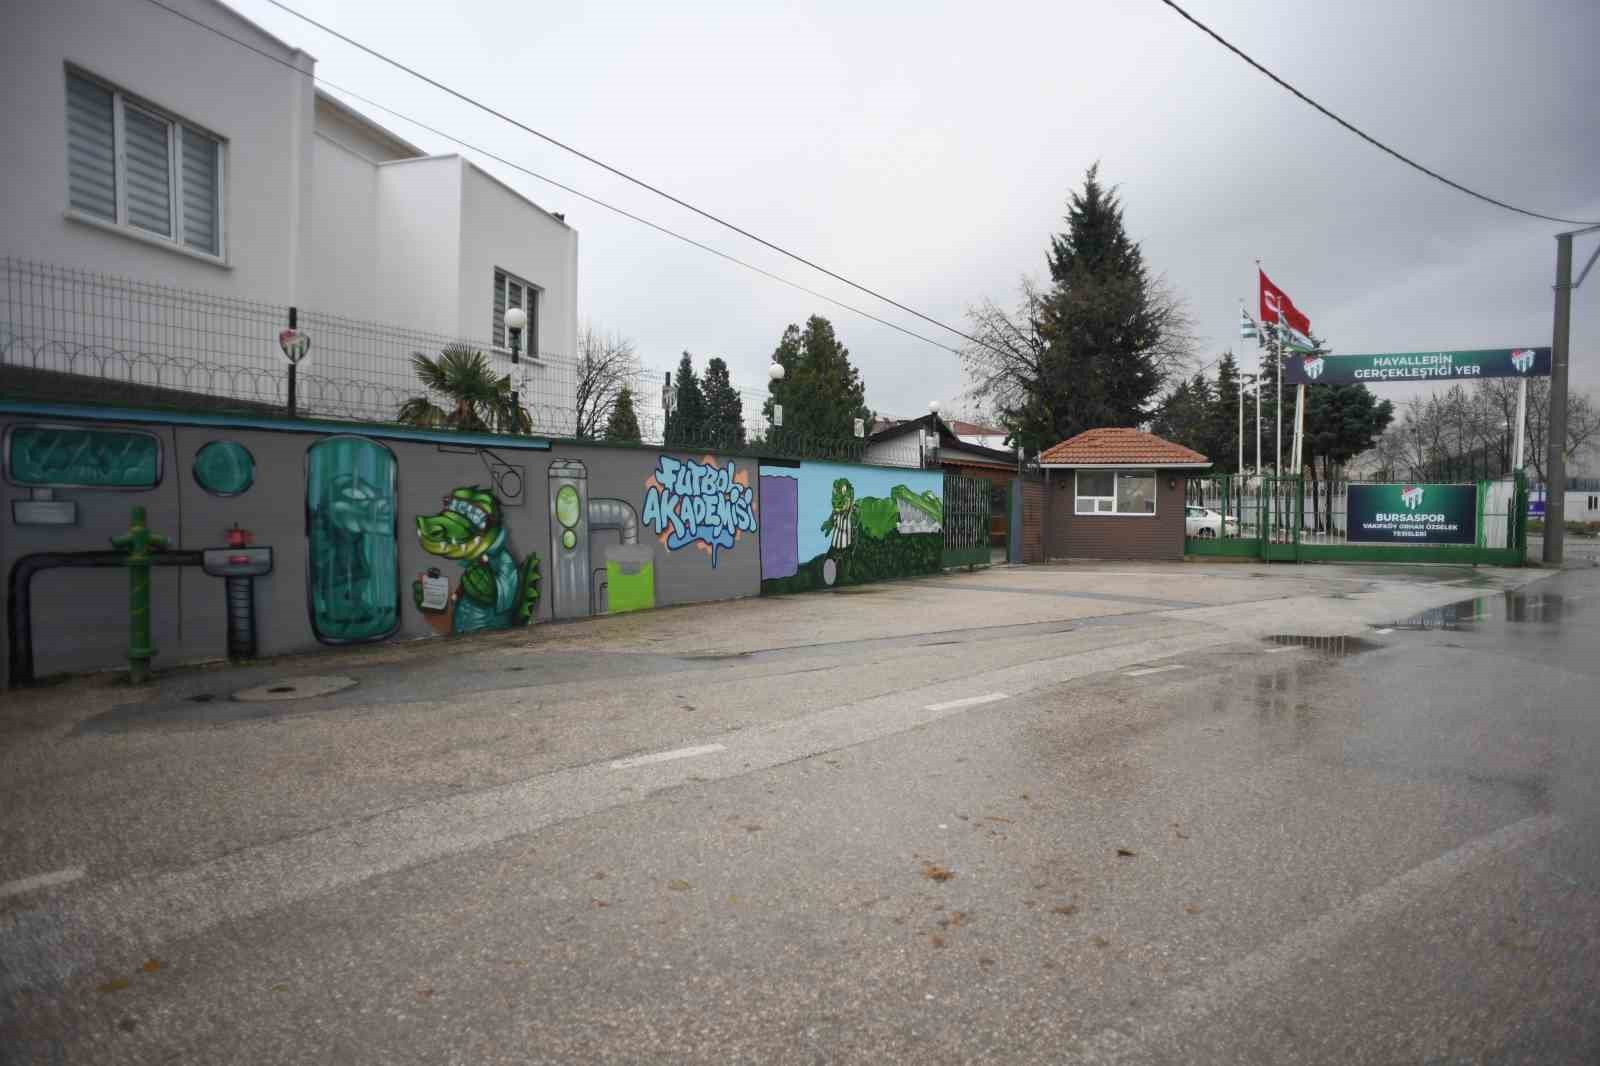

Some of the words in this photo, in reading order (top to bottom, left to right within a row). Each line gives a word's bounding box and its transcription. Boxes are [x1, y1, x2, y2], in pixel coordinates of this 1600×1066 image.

[1373, 353, 1453, 366] HAYALLERİN
[1354, 365, 1452, 379] GERÇEKLEŞTİĞİ
[1455, 365, 1481, 376] YER
[655, 455, 744, 496] FUTBOL
[1375, 513, 1445, 522] BURSASPOR
